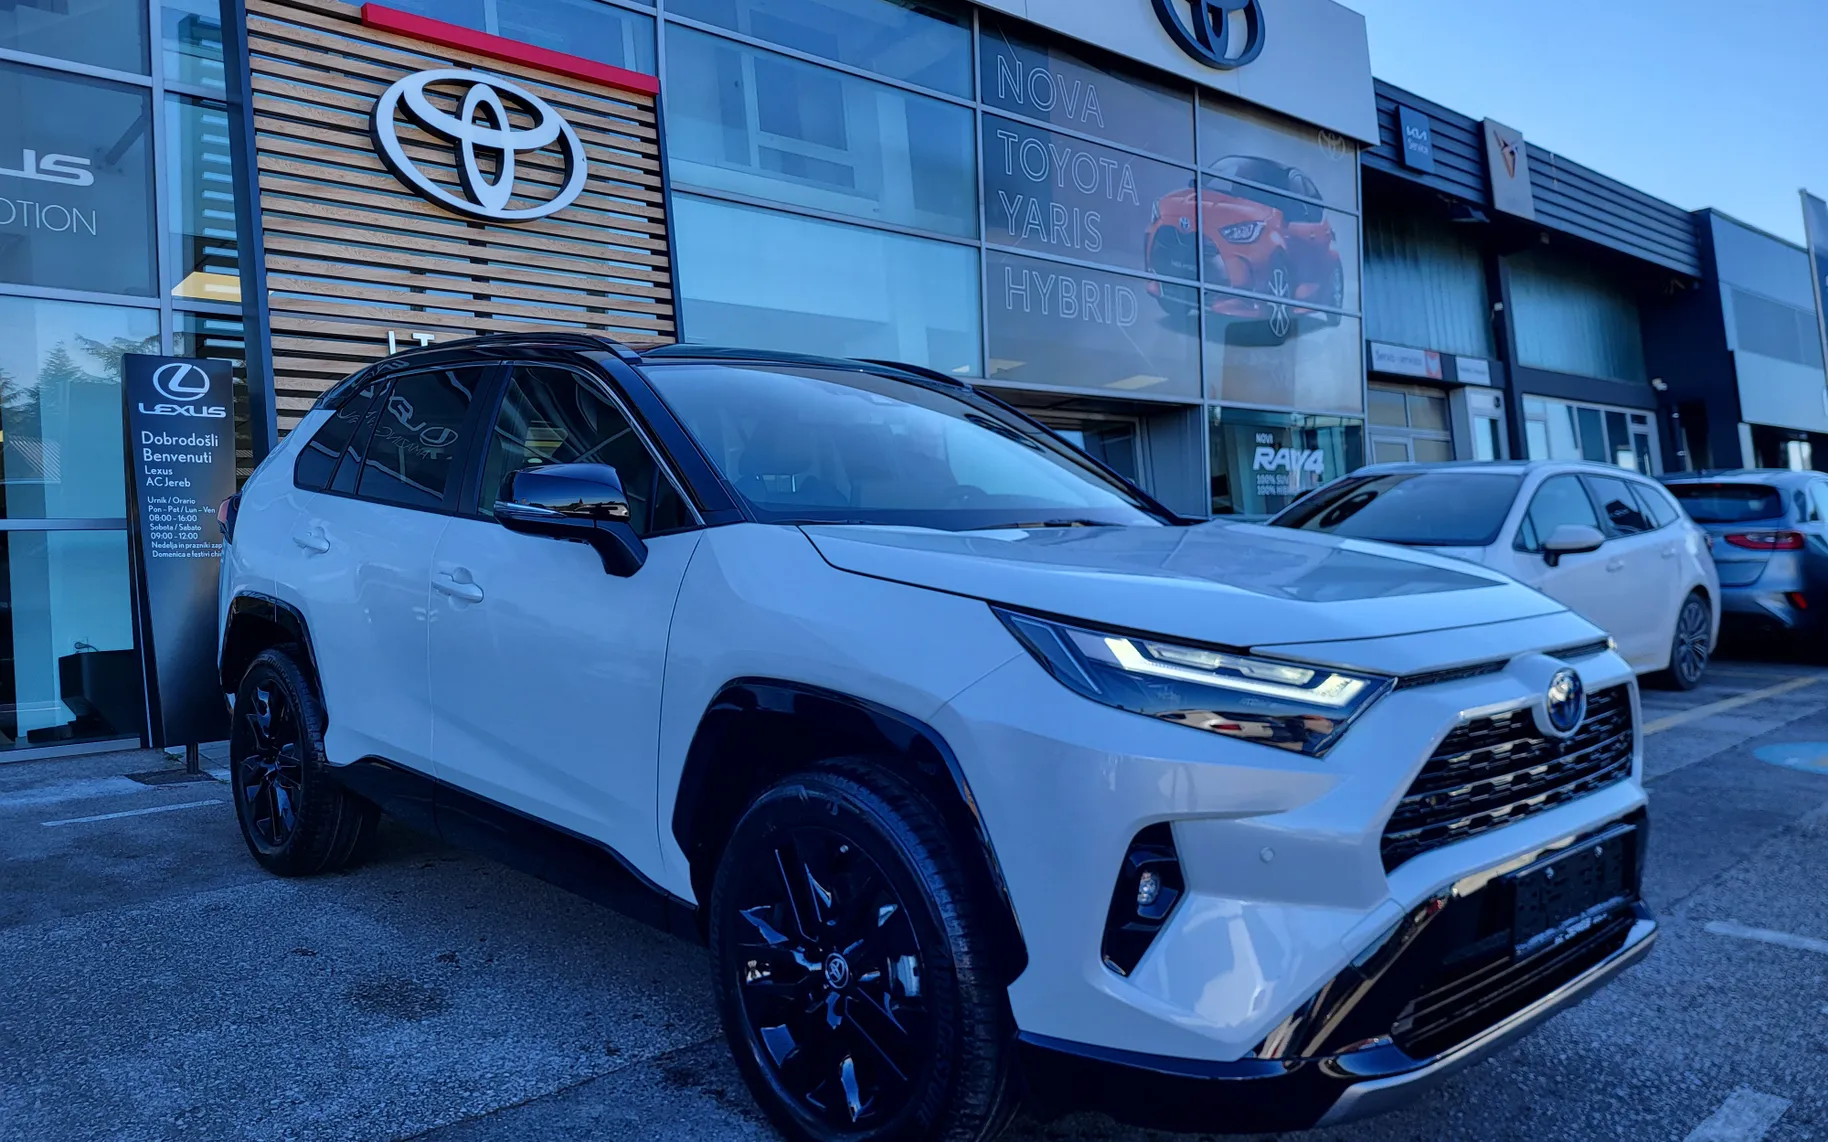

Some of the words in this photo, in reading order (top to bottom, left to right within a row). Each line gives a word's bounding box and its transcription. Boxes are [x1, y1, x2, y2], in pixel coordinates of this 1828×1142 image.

[997, 55, 1104, 128] NOVA
[997, 129, 1140, 206] TOYOTA
[998, 190, 1102, 253] YARIS
[1004, 266, 1138, 327] HYBRID
[138, 402, 227, 418] LEXUS
[141, 430, 218, 447] Dobrodošli
[143, 447, 212, 463] Benvenuti
[1252, 446, 1325, 475] RAV4
[144, 465, 173, 475] Lexus
[147, 496, 167, 504] Urnik
[172, 496, 196, 505] Orario
[148, 505, 162, 513] Pon
[167, 505, 180, 513] Pet
[202, 506, 216, 514] Ven
[149, 514, 172, 522] 08:00
[177, 514, 198, 522] 16:00
[149, 523, 174, 531] Sobota
[178, 523, 202, 531] Sabato
[150, 532, 173, 540] 09:00
[178, 532, 199, 540] 12:00
[151, 541, 178, 550] Nedelja
[185, 542, 211, 550] prazniki
[152, 550, 186, 558] Domenica
